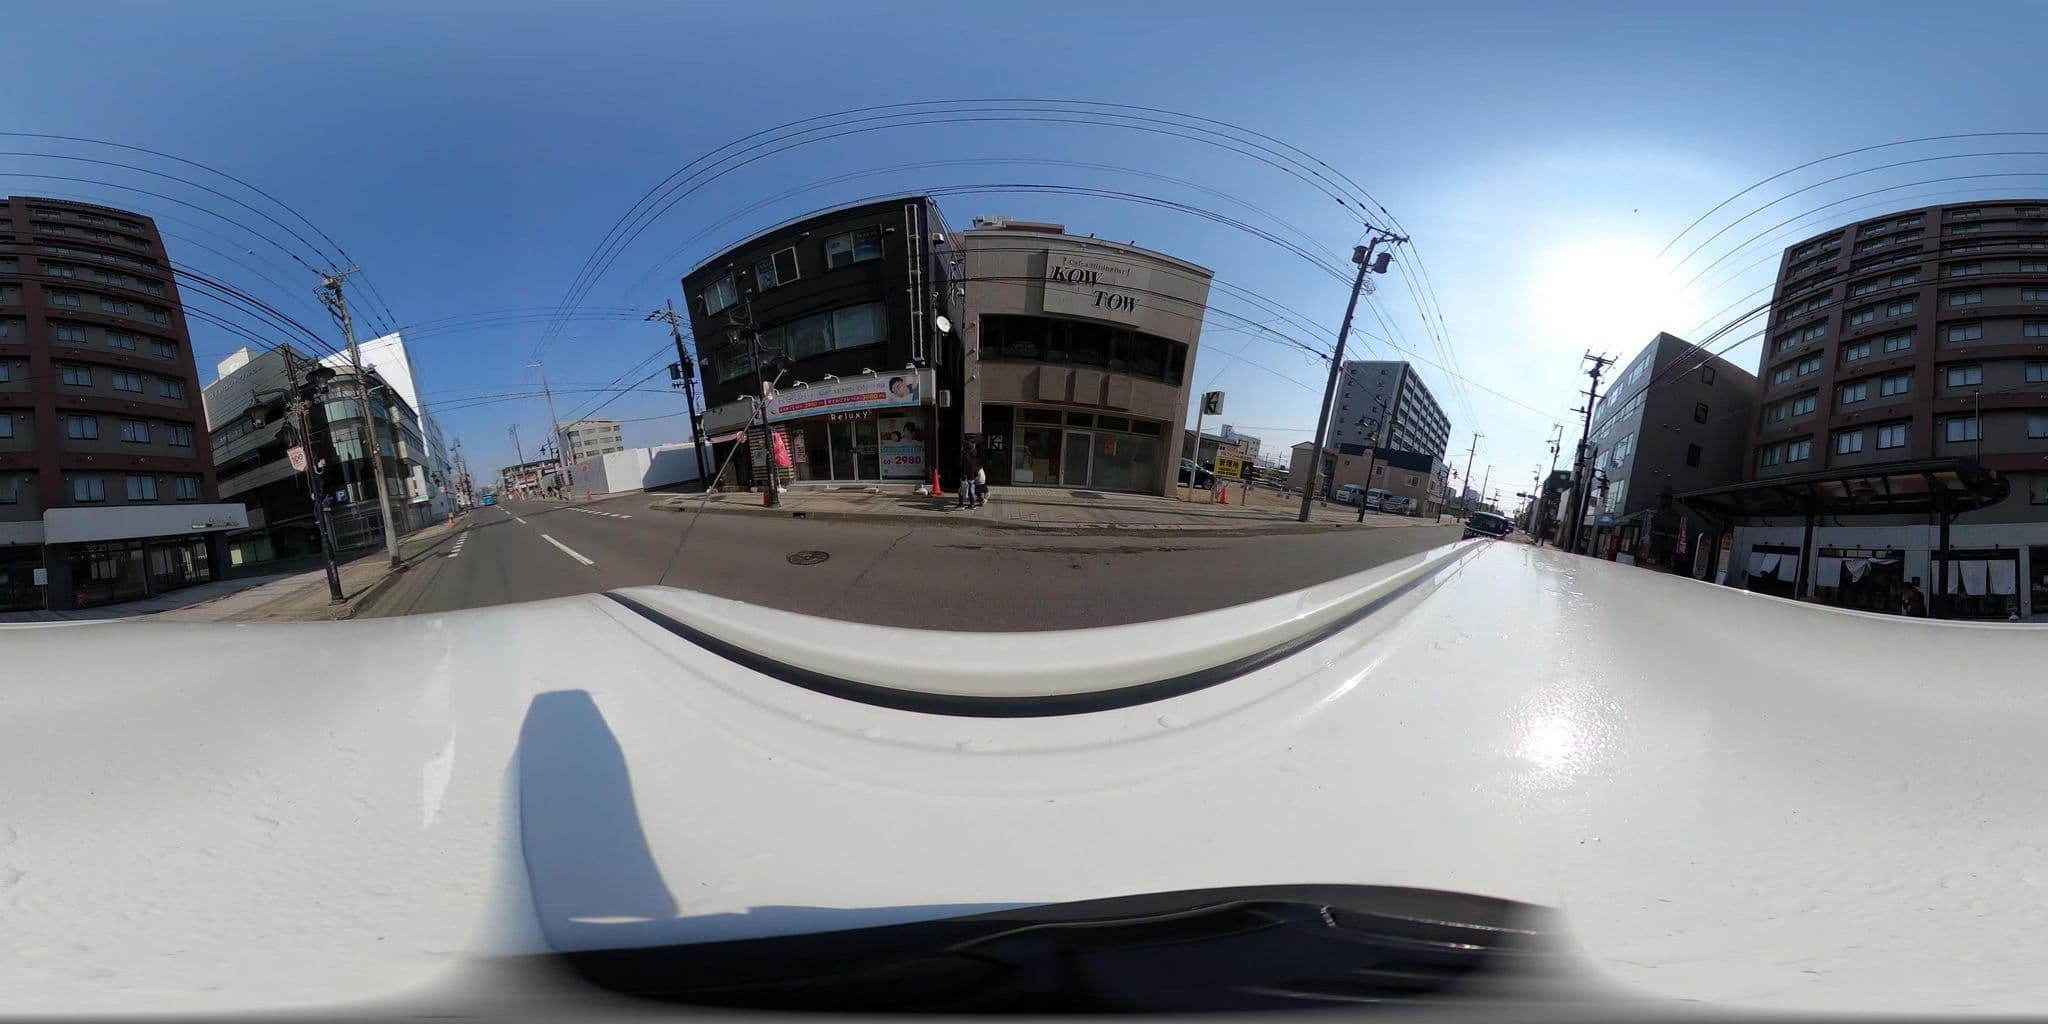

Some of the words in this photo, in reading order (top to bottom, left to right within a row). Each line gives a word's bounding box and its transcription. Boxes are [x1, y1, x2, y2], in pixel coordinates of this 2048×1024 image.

[1051, 265, 1103, 287] KOW
[1094, 290, 1137, 313] TOW
[831, 410, 868, 422] Reluxy
[895, 456, 921, 465] 2980
